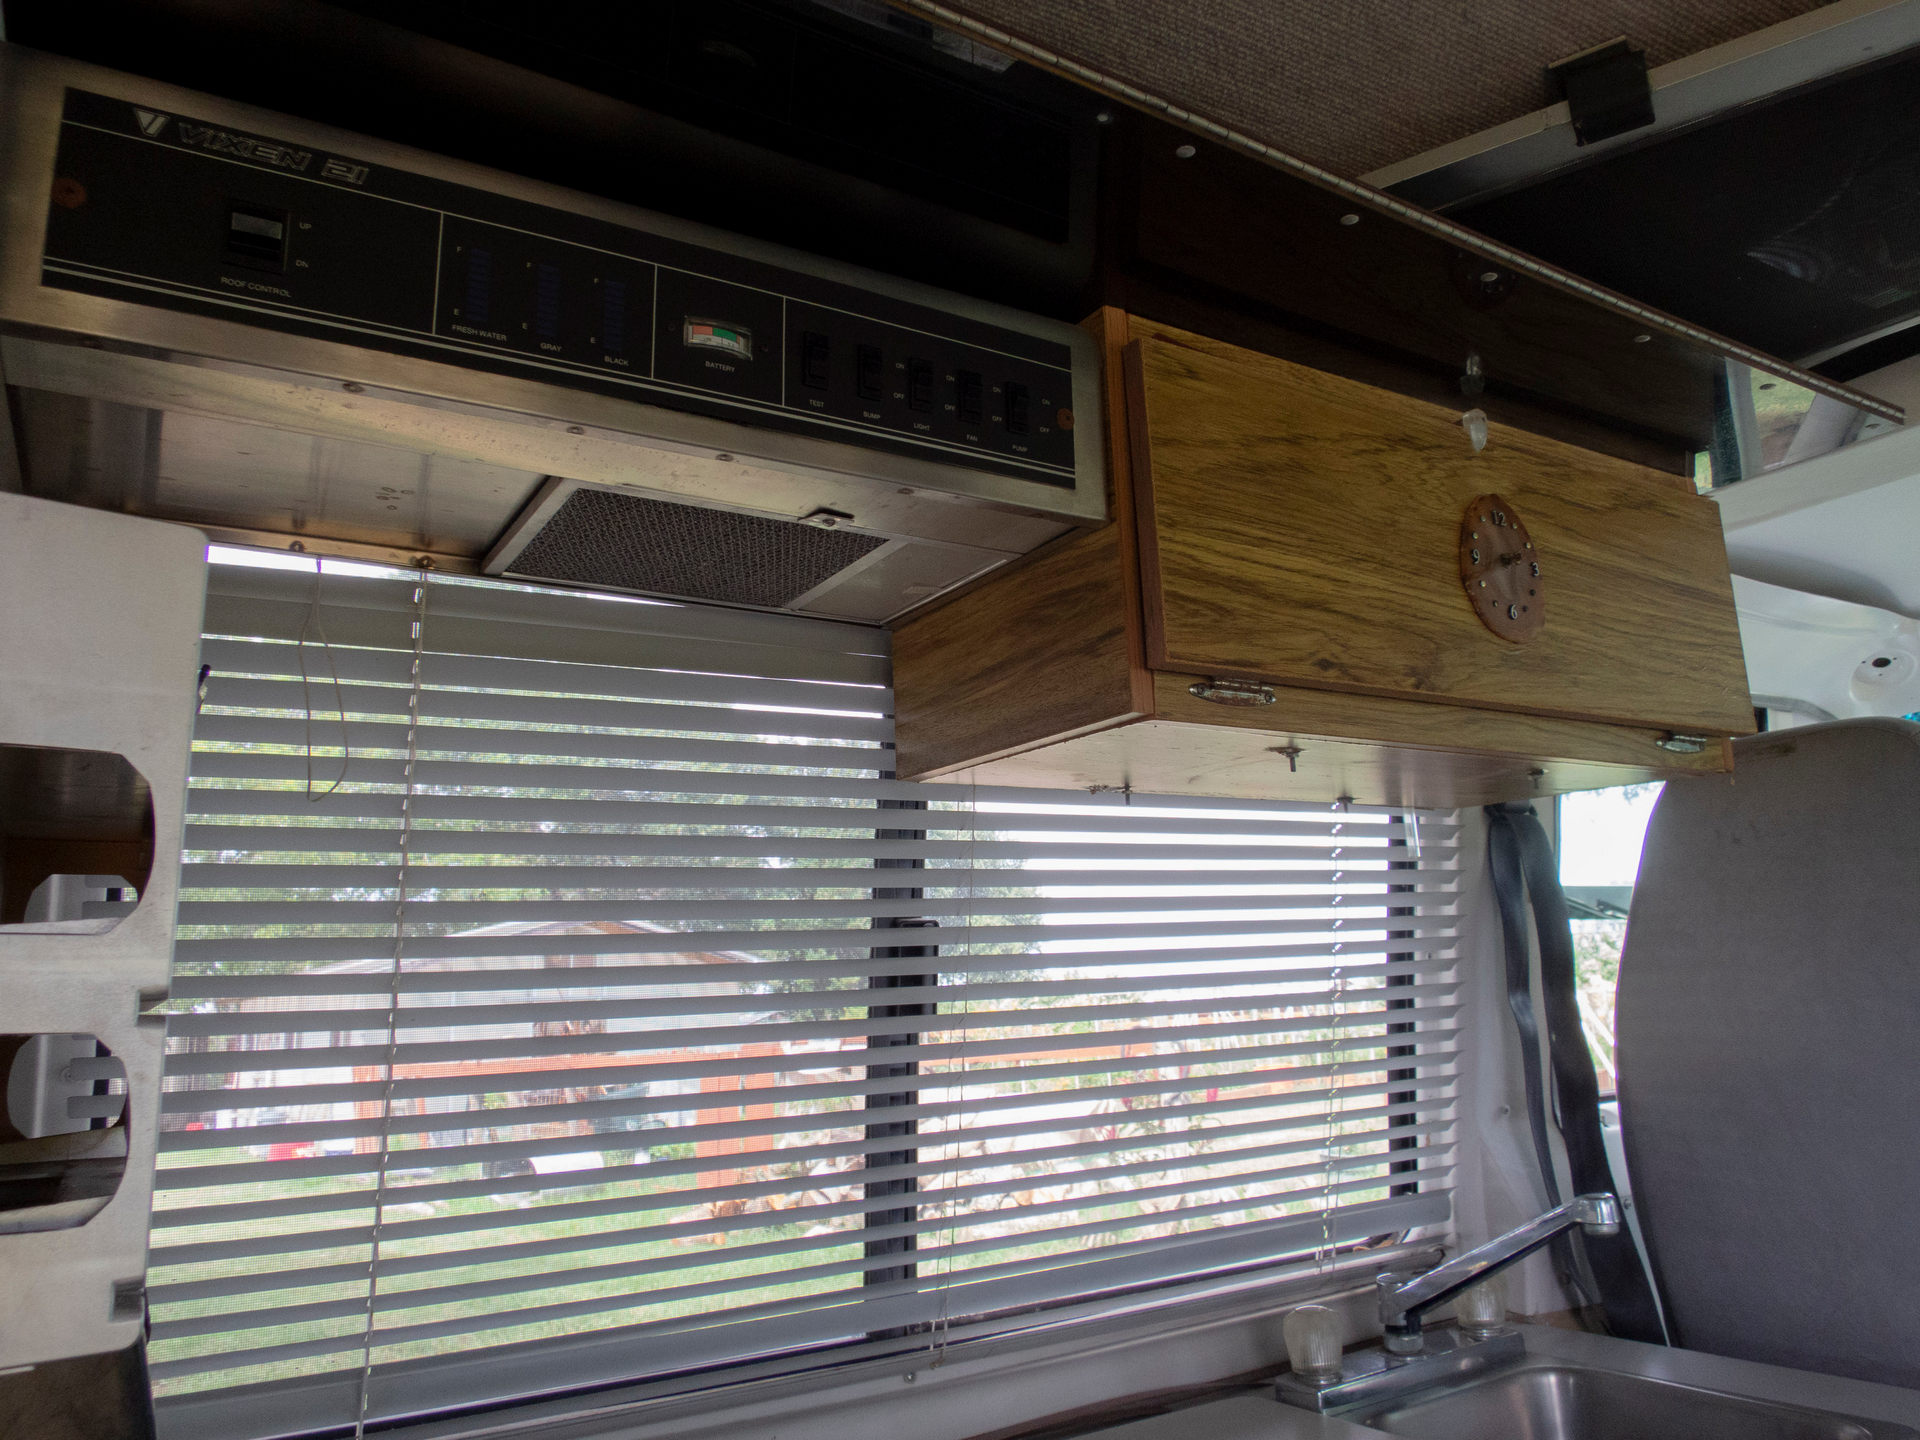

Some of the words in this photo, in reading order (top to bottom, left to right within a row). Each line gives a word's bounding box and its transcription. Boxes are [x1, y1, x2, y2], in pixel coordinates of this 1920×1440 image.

[178, 121, 313, 172] VIXEN
[321, 158, 370, 185] 21
[299, 221, 313, 230] UP
[220, 275, 247, 288] ROOF
[247, 281, 292, 299] CONTROL
[451, 323, 479, 337] FRESH
[478, 328, 507, 343] WATER
[539, 341, 562, 353] GRAY
[603, 354, 630, 367] BLACK
[704, 360, 736, 373] BATTERY
[808, 399, 825, 409] TEST
[913, 422, 931, 432] LIGHT
[966, 433, 979, 443] FAN
[1491, 510, 1507, 527] 12
[1471, 548, 1481, 565] 9
[1530, 561, 1541, 578] 3
[1508, 603, 1518, 621] 6
